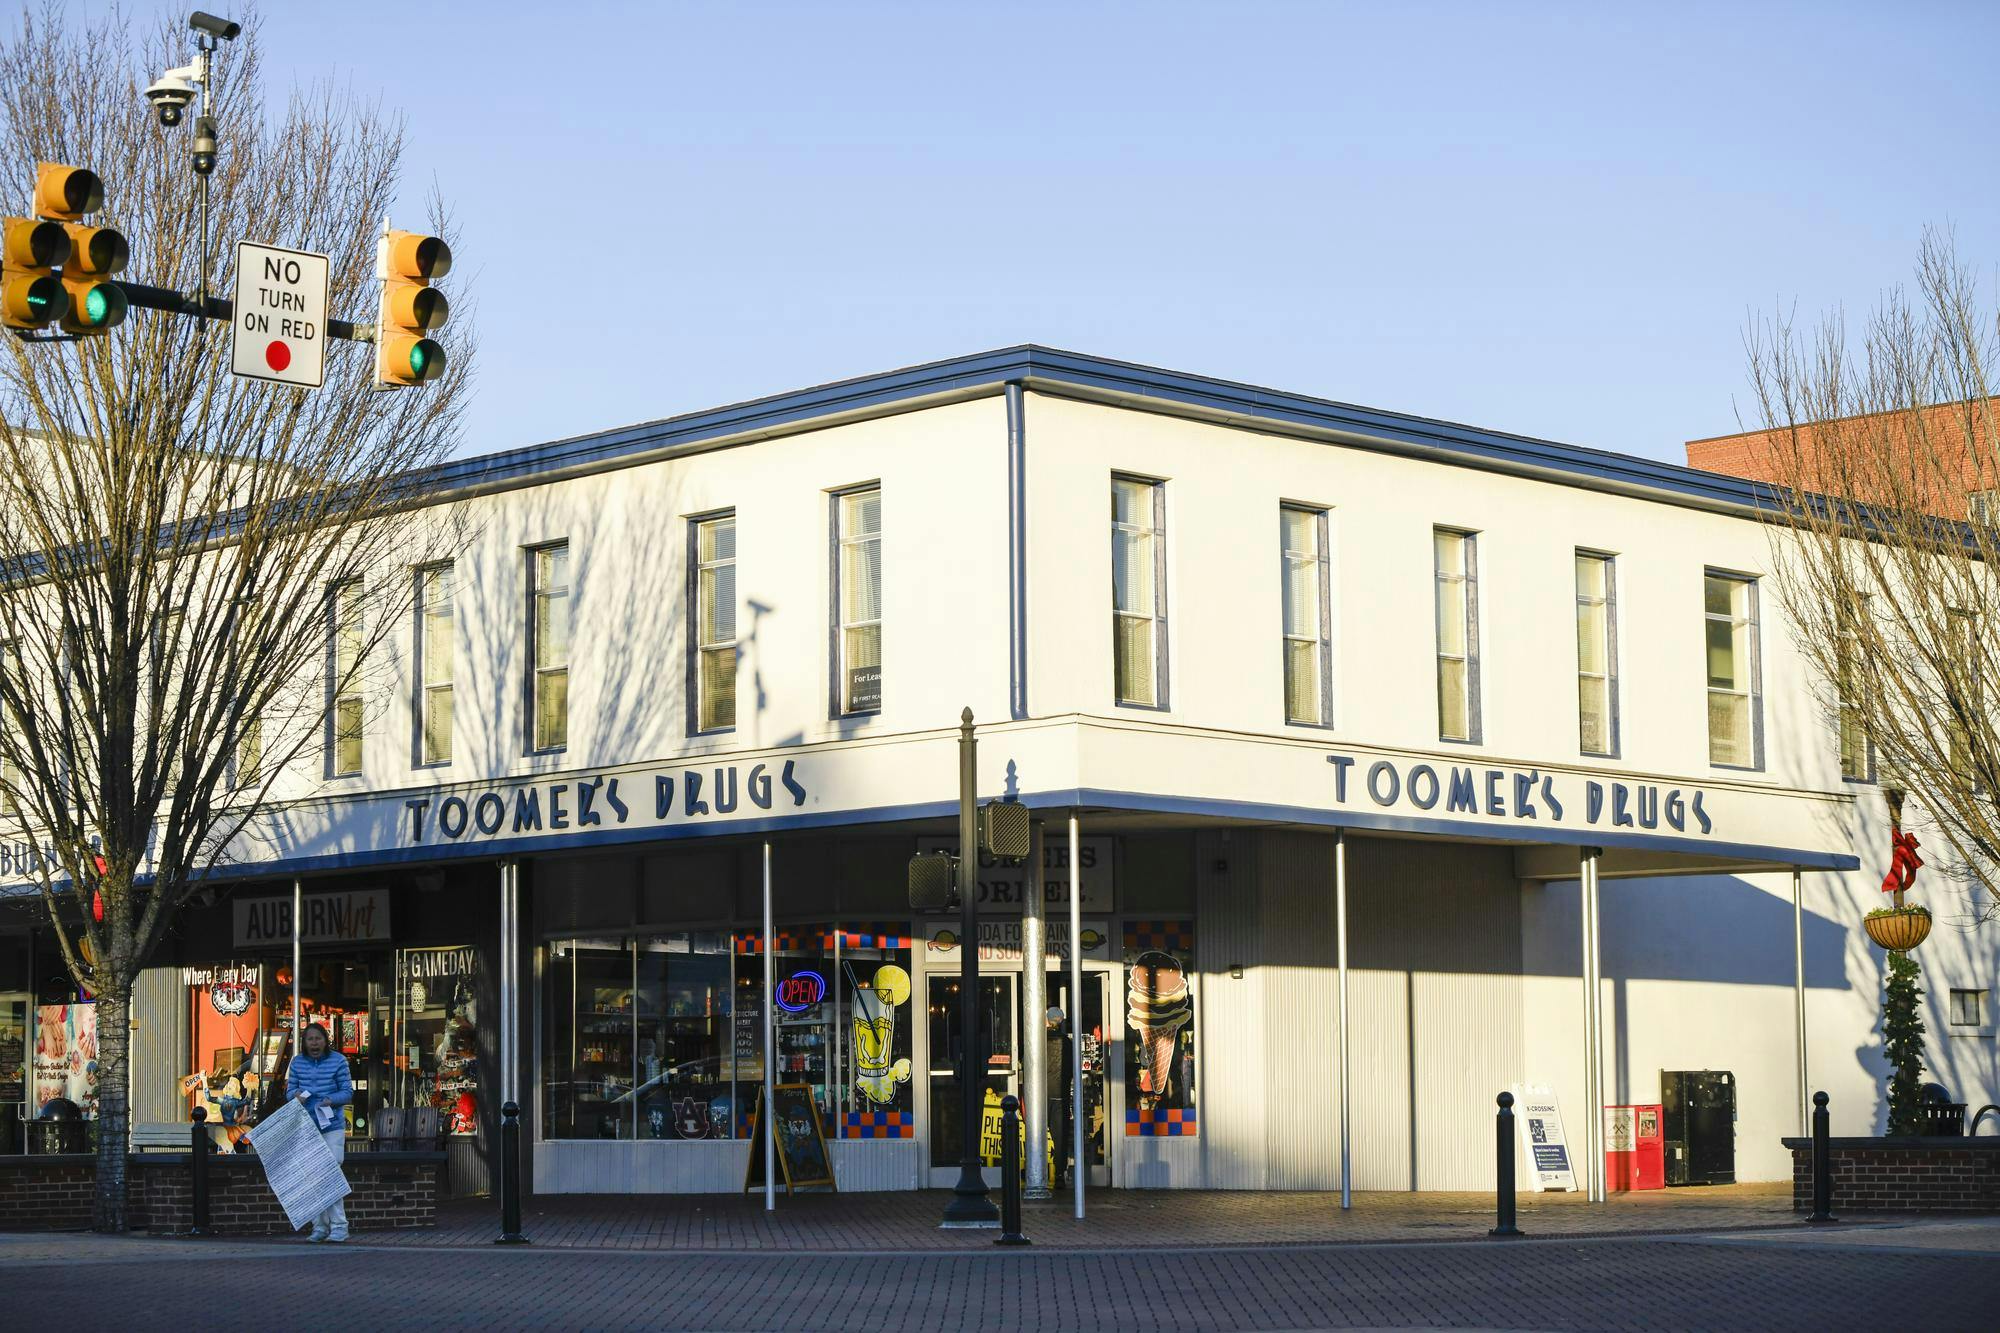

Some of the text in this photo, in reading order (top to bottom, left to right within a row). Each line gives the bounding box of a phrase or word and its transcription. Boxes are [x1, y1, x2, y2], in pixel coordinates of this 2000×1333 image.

[264, 256, 301, 285] NO
[259, 287, 305, 313] TURN
[245, 312, 315, 341] ON RED
[854, 674, 866, 683] For
[405, 760, 806, 842] TOOMER'S DRUGS
[1326, 755, 1711, 835] TOOMER'S DRUGS
[183, 964, 258, 985] Where Every Day
[399, 949, 474, 979] is GAMEDAY
[781, 979, 818, 1003] OPEN
[185, 1074, 201, 1087] OPEN
